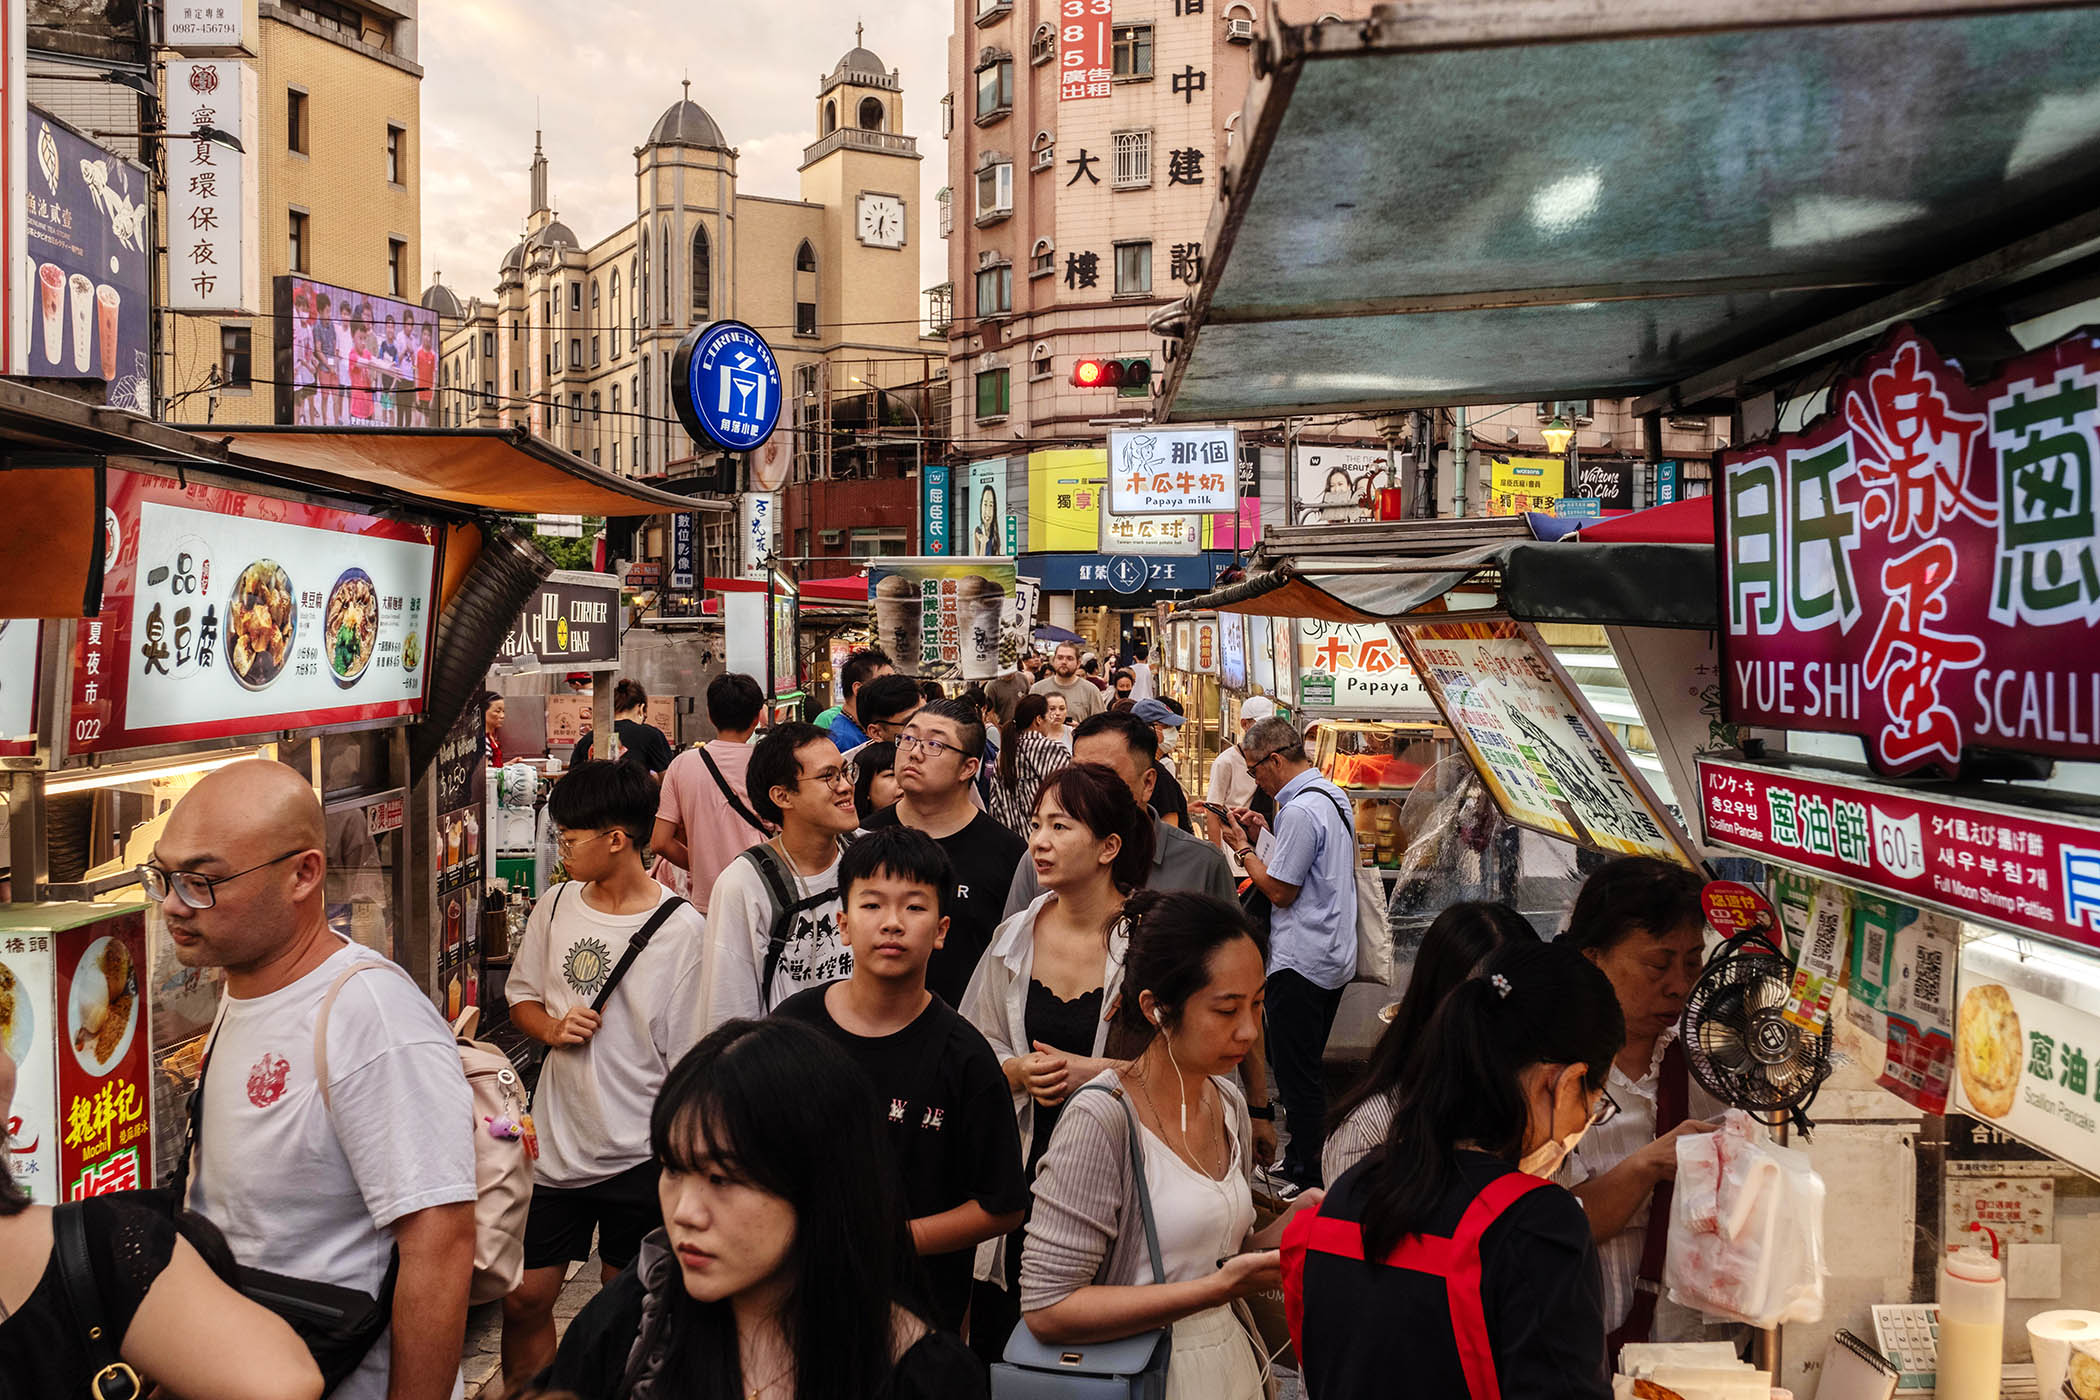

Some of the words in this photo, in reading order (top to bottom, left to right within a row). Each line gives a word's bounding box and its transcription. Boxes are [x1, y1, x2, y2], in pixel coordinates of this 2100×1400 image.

[172, 24, 235, 33] 0987-456794
[1062, 68, 1113, 84] 廣告
[1063, 82, 1111, 99] 出租
[188, 104, 219, 299] 寧夏環保夜市
[1064, 148, 1100, 290] 大樓
[703, 332, 755, 370] CORNER
[757, 344, 777, 385] BAR
[720, 418, 760, 437] 角落小吧
[1172, 440, 1229, 465] 那個
[1126, 471, 1225, 494] 木瓜牛奶
[1580, 466, 1620, 485] Watsons
[1145, 496, 1183, 507] Papaya
[1188, 496, 1212, 504] milk
[1595, 483, 1620, 499] Club
[930, 488, 943, 536] 屈臣氏
[1112, 520, 1183, 538] 地瓜球
[147, 552, 196, 595] 一品
[1080, 565, 1108, 580] 紅茶
[1149, 564, 1177, 579] 之王
[570, 600, 607, 623] CORNER
[570, 630, 590, 652] BAR
[1347, 677, 1409, 696] Papaya
[1736, 659, 1796, 714] YUE
[1803, 661, 1860, 720] SHI
[76, 719, 101, 741] 022
[1709, 816, 1734, 835] Scallion
[1734, 822, 1764, 842] Pancake
[1766, 786, 1871, 868] 蔥油餅
[957, 884, 969, 898] R
[1933, 874, 1950, 894] Full
[1952, 881, 1979, 901] Moon
[1980, 886, 2015, 914] Shrimp
[2016, 896, 2054, 922] Patties
[1731, 909, 1747, 926] 3
[2024, 1085, 2056, 1115] Scallion
[2058, 1101, 2096, 1134] Pancake
[82, 1138, 108, 1161] Mochi
